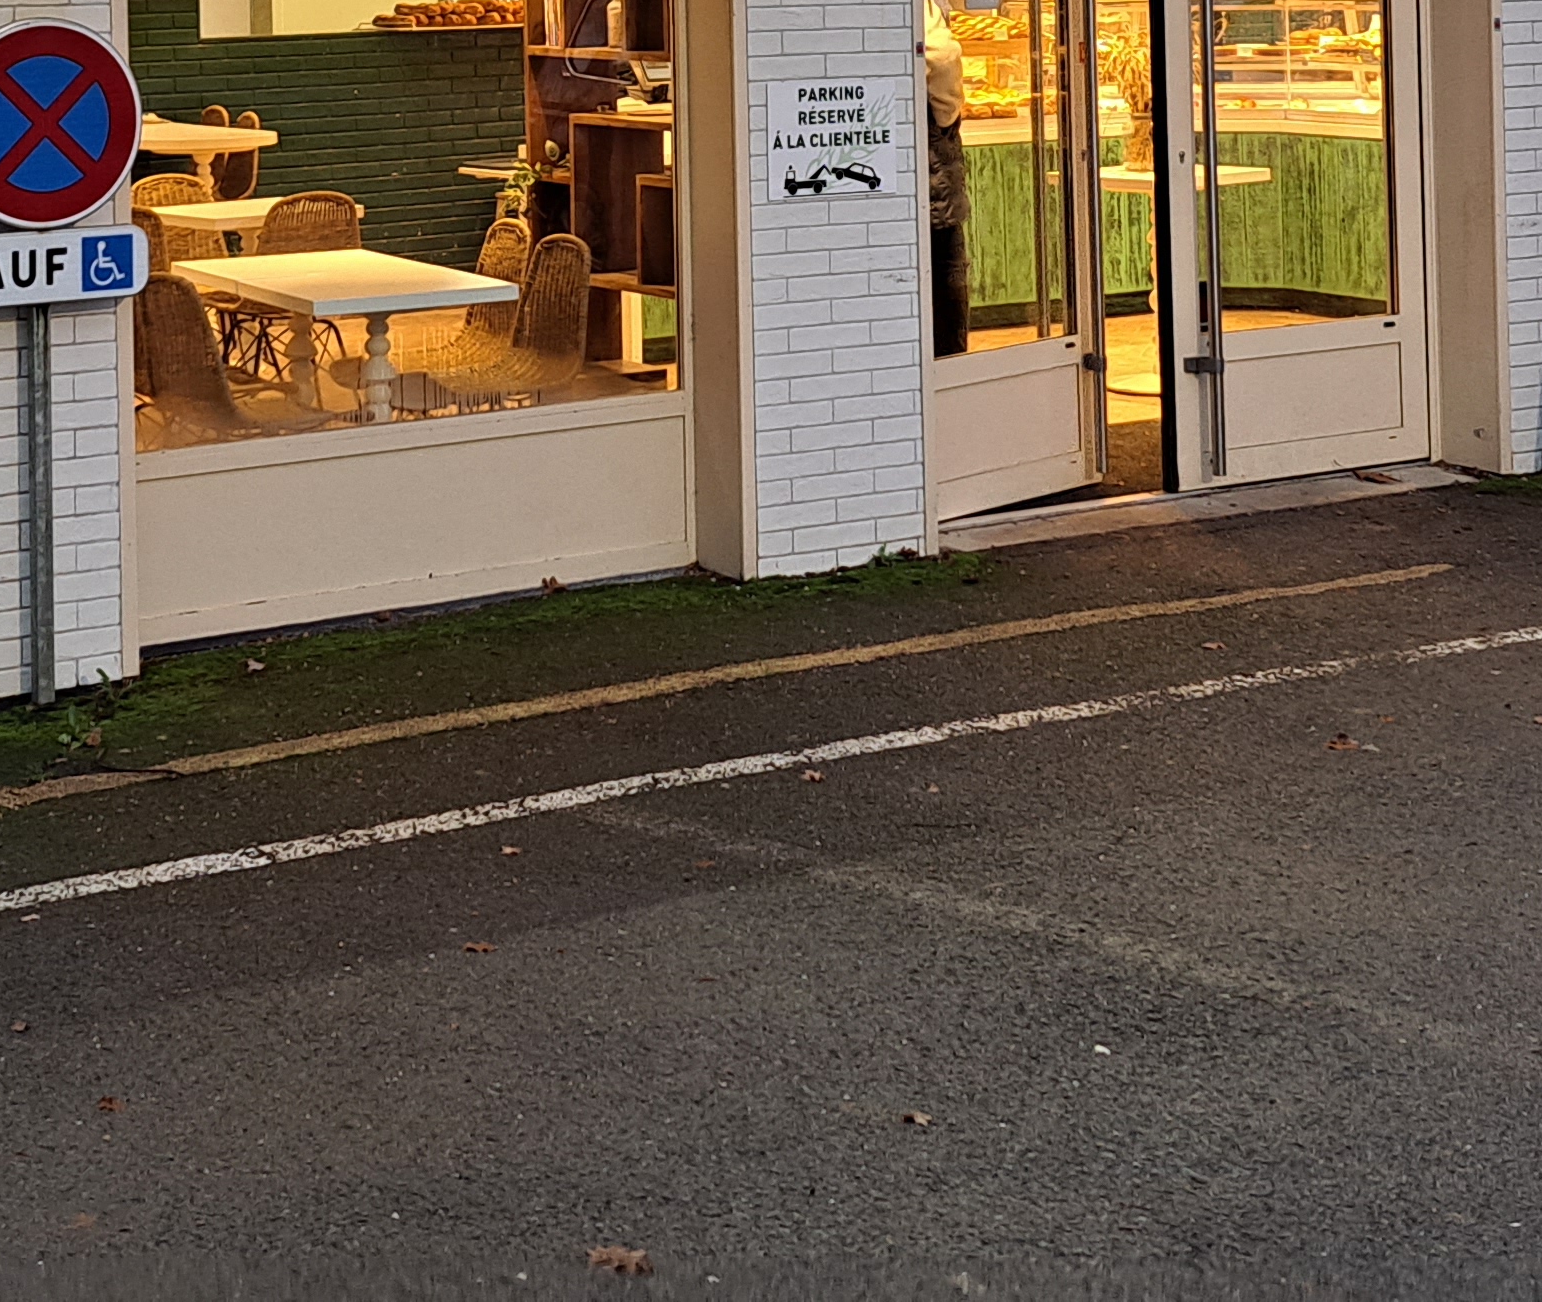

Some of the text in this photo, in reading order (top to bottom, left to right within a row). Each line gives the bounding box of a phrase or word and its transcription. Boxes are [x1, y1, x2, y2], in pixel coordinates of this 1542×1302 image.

[798, 85, 865, 103] PARKING
[798, 103, 866, 125] RÉSERVÉ
[786, 133, 806, 149] LA
[809, 126, 891, 148] CLIENTÈLE
